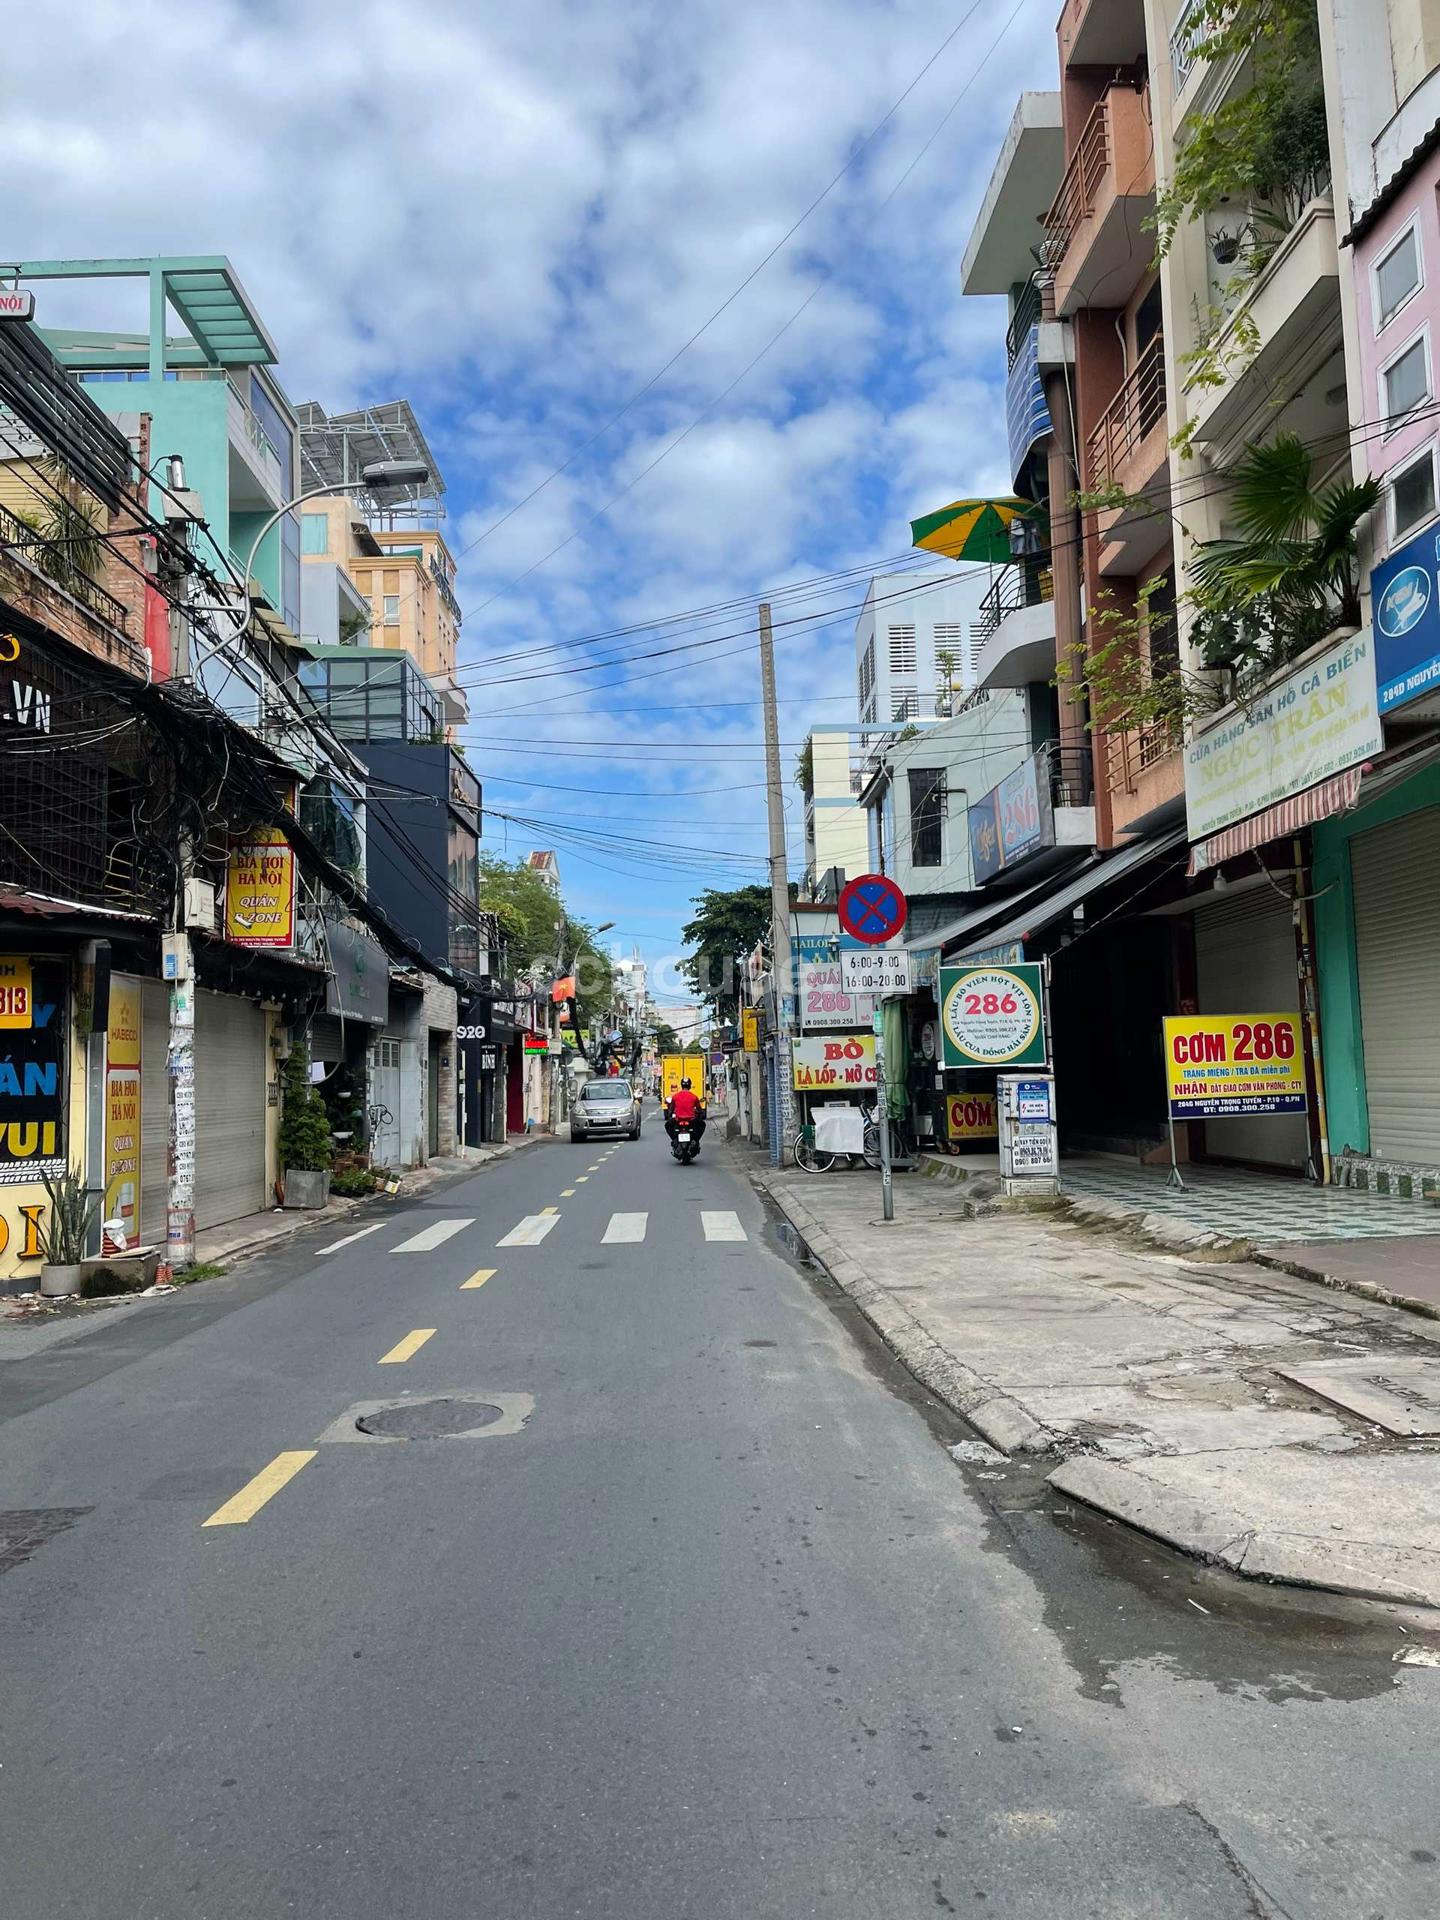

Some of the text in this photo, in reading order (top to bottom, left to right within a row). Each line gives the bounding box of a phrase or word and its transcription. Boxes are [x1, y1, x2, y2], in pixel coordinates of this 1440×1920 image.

[1406, 659, 1440, 690] NGUYỄ
[239, 893, 279, 908] QUÁN
[850, 956, 900, 969] 6:00-9:00
[845, 974, 906, 988] 16:00-20:00
[806, 990, 851, 1013] 286
[964, 993, 1018, 1015] 286
[823, 1037, 865, 1061] BÒ
[1173, 1021, 1295, 1064] CƠM 286
[1173, 1079, 1208, 1098] NHẬN
[951, 1097, 993, 1128] CƠM
